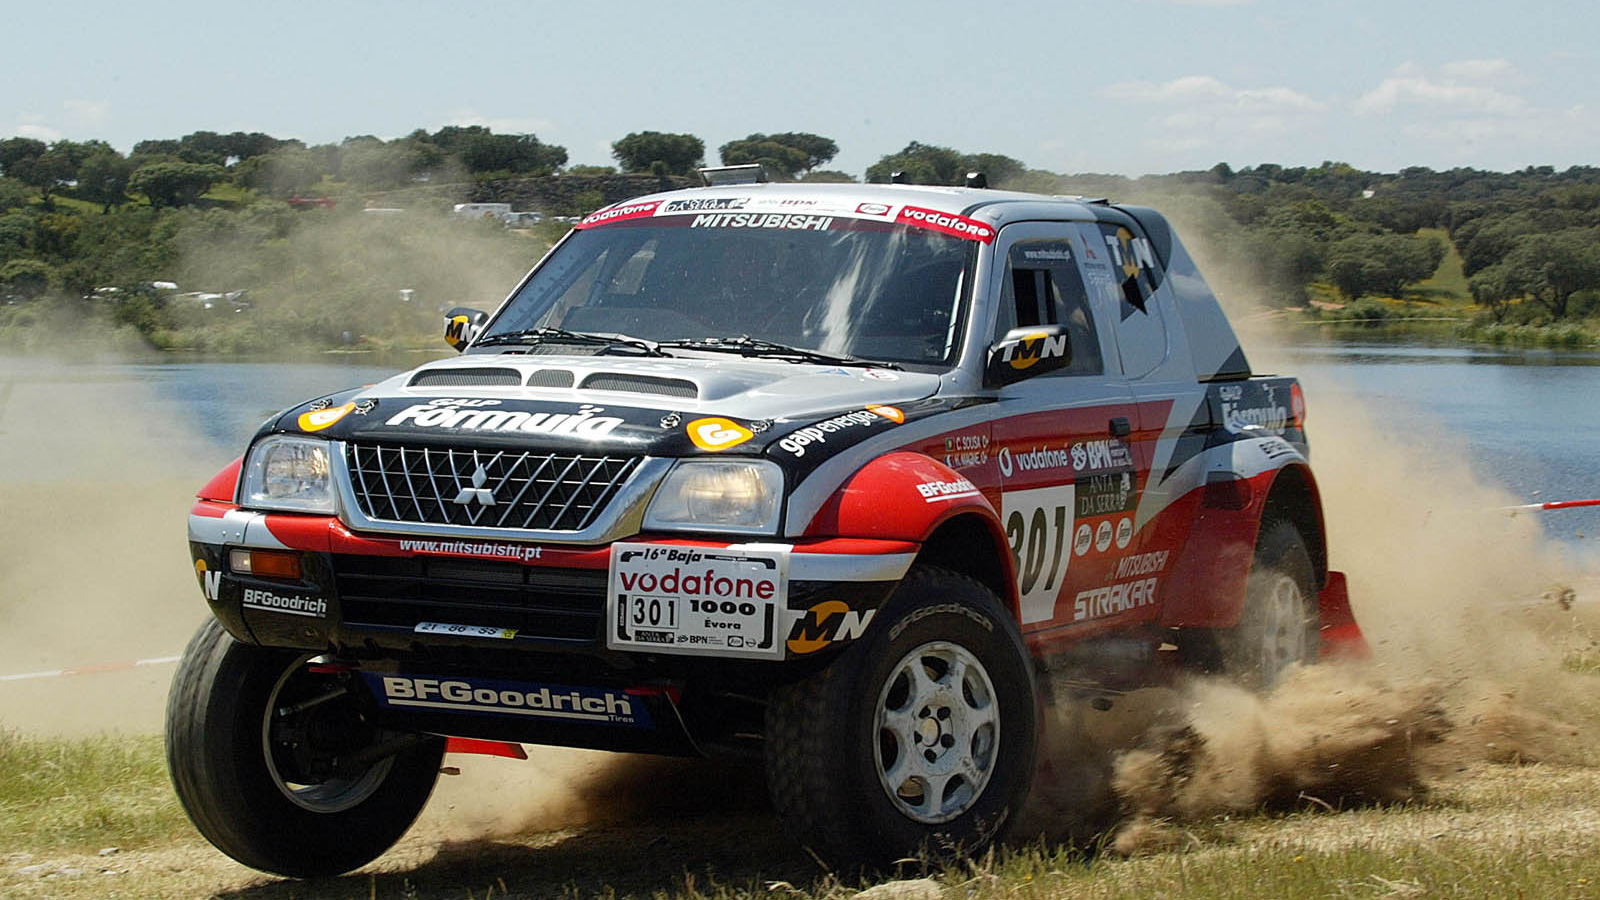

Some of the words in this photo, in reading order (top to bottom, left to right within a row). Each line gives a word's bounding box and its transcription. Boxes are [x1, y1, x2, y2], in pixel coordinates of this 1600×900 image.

[582, 204, 656, 224] vodafone
[690, 213, 833, 231] MITSUBISHI
[903, 208, 989, 237] vodafone
[1002, 335, 1067, 363] TMN
[429, 398, 502, 408] GALP
[962, 435, 981, 450] SOUSA
[1016, 446, 1068, 471] vodafone
[1086, 440, 1112, 470] BPN
[1089, 474, 1114, 493] ANTA
[1081, 497, 1095, 515] DA
[1096, 494, 1120, 513] SERRA
[400, 540, 543, 561] www.mitsubishi.pt
[667, 550, 702, 565] Baja
[1006, 506, 1066, 596] 301
[1115, 550, 1170, 579] MITSUBISHI
[620, 568, 775, 599] vodafone
[243, 589, 327, 613] BFGoodrich
[690, 600, 756, 616] 1000
[1074, 577, 1157, 621] STRAKAR
[633, 598, 674, 626] 301
[704, 617, 742, 630] Évora
[786, 608, 877, 642] TMN
[689, 635, 708, 645] BPN
[383, 677, 632, 715] BFGoodrich
[608, 714, 635, 723] Tires
